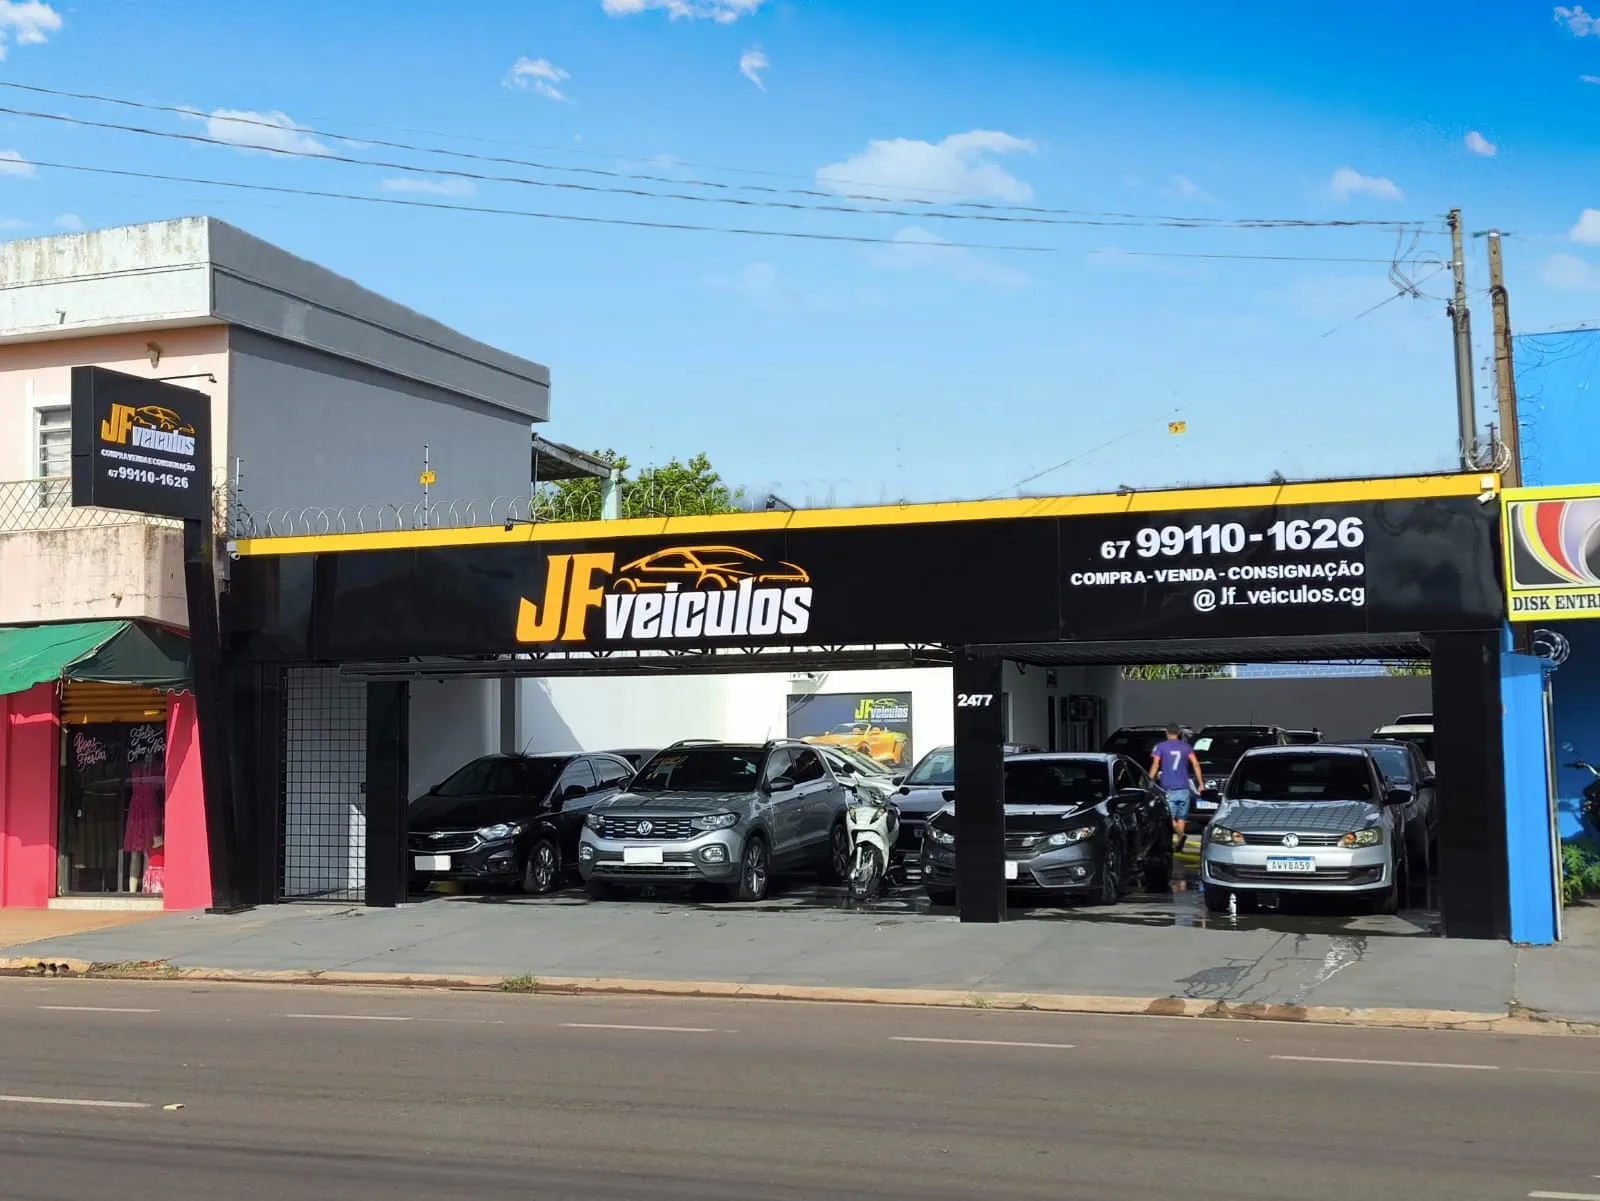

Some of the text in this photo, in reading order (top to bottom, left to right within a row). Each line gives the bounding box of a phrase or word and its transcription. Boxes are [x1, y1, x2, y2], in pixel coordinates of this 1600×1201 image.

[101, 403, 135, 444] JF
[108, 466, 189, 489] 67 99110-1626
[1100, 516, 1364, 559] 67 99110-1626
[516, 552, 813, 643] JF veiculos
[1512, 595, 1550, 611] DISK
[957, 693, 993, 707] 2477
[1170, 750, 1181, 771] 7
